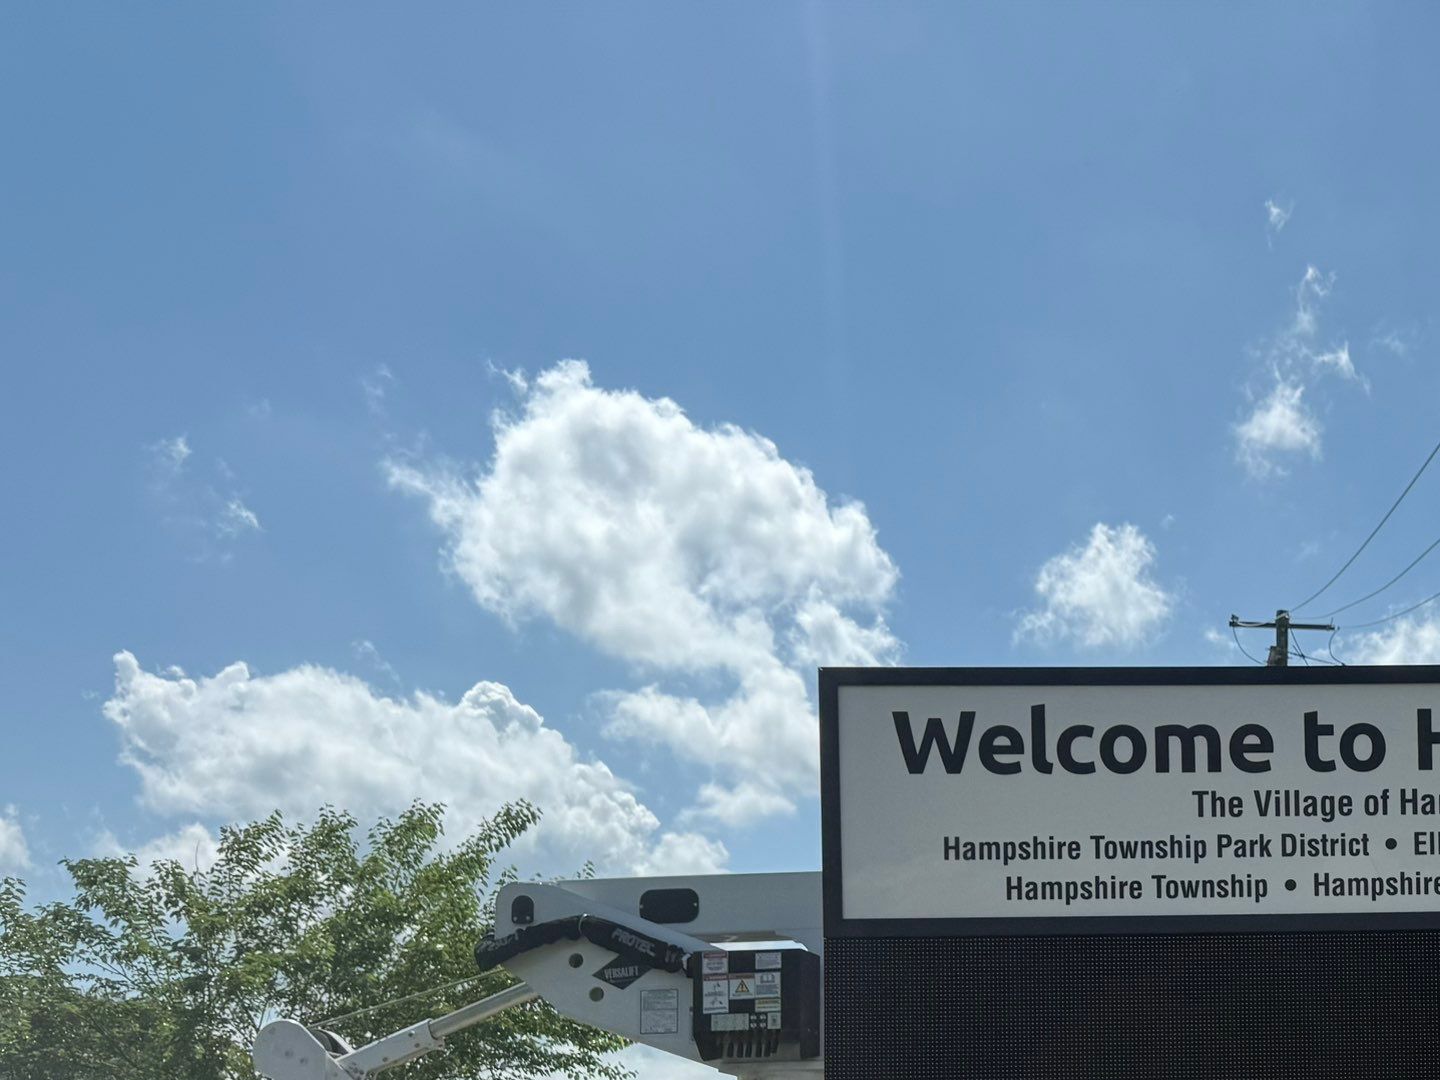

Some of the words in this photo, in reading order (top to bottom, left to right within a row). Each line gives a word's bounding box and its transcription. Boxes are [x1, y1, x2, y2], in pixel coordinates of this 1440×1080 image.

[892, 704, 1274, 775] Welcome
[1304, 711, 1386, 773] to
[1192, 790, 1243, 817] The
[1254, 790, 1352, 822] Village
[1364, 788, 1389, 816] of
[944, 836, 1080, 866] Hampshire
[1090, 835, 1206, 864] Township
[1217, 834, 1272, 858] Park
[1281, 833, 1369, 857] District
[1006, 876, 1142, 905] Hampshire
[1151, 874, 1267, 903] Township
[611, 928, 656, 957] PROTEC
[604, 966, 639, 979] VERSALIFT
